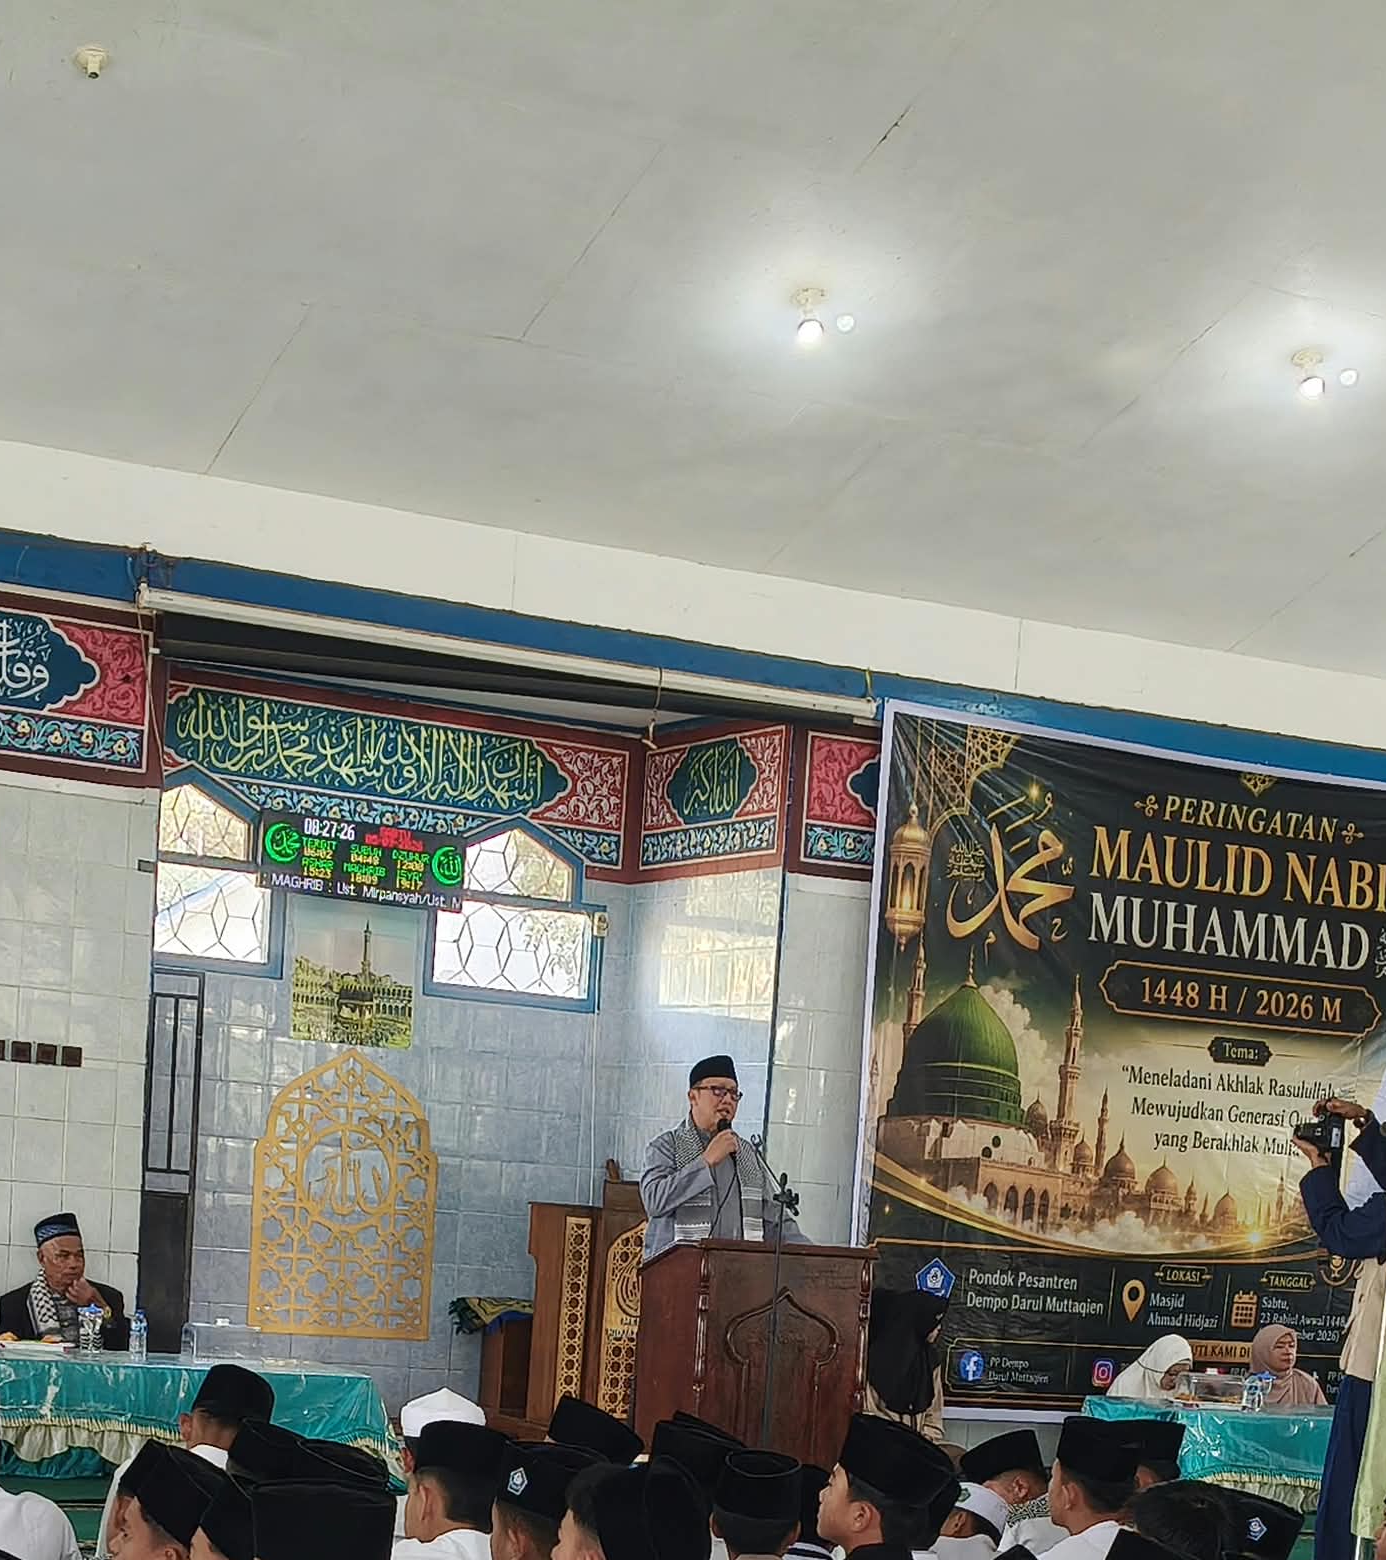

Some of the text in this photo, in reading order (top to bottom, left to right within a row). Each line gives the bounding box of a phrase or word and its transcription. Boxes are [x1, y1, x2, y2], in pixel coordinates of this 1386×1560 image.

[304, 817, 356, 841] 08:27:26
[1163, 795, 1338, 843] PERINGATAN
[1089, 825, 1273, 897] MAULID
[271, 873, 324, 892] MAGHRIB
[1087, 892, 1371, 971] MUHAMMAD
[1141, 975, 1343, 1023] 1448 H / 2026 M
[1222, 1042, 1259, 1061] Tema:
[1216, 1073, 1264, 1096] Akhlak
[1131, 1096, 1224, 1123] Mewujudkan
[1228, 1105, 1286, 1127] Generasi
[1154, 1131, 1188, 1152] yang
[1192, 1131, 1260, 1154] Berakhlak
[968, 1268, 1078, 1291] Pondok Pesantren
[1166, 1269, 1201, 1282] LOKASI
[1269, 1275, 1310, 1289] TANGGAL
[966, 1291, 1009, 1312] Dempo
[1011, 1294, 1043, 1312] Darul
[1045, 1297, 1104, 1317] Muttaqien
[1149, 1293, 1185, 1309] Masjid
[1146, 1312, 1220, 1331] Ahmad Hidjazi
[1260, 1312, 1271, 1324] 23
[1211, 1344, 1237, 1358] KAMI
[1240, 1346, 1251, 1358] DI
